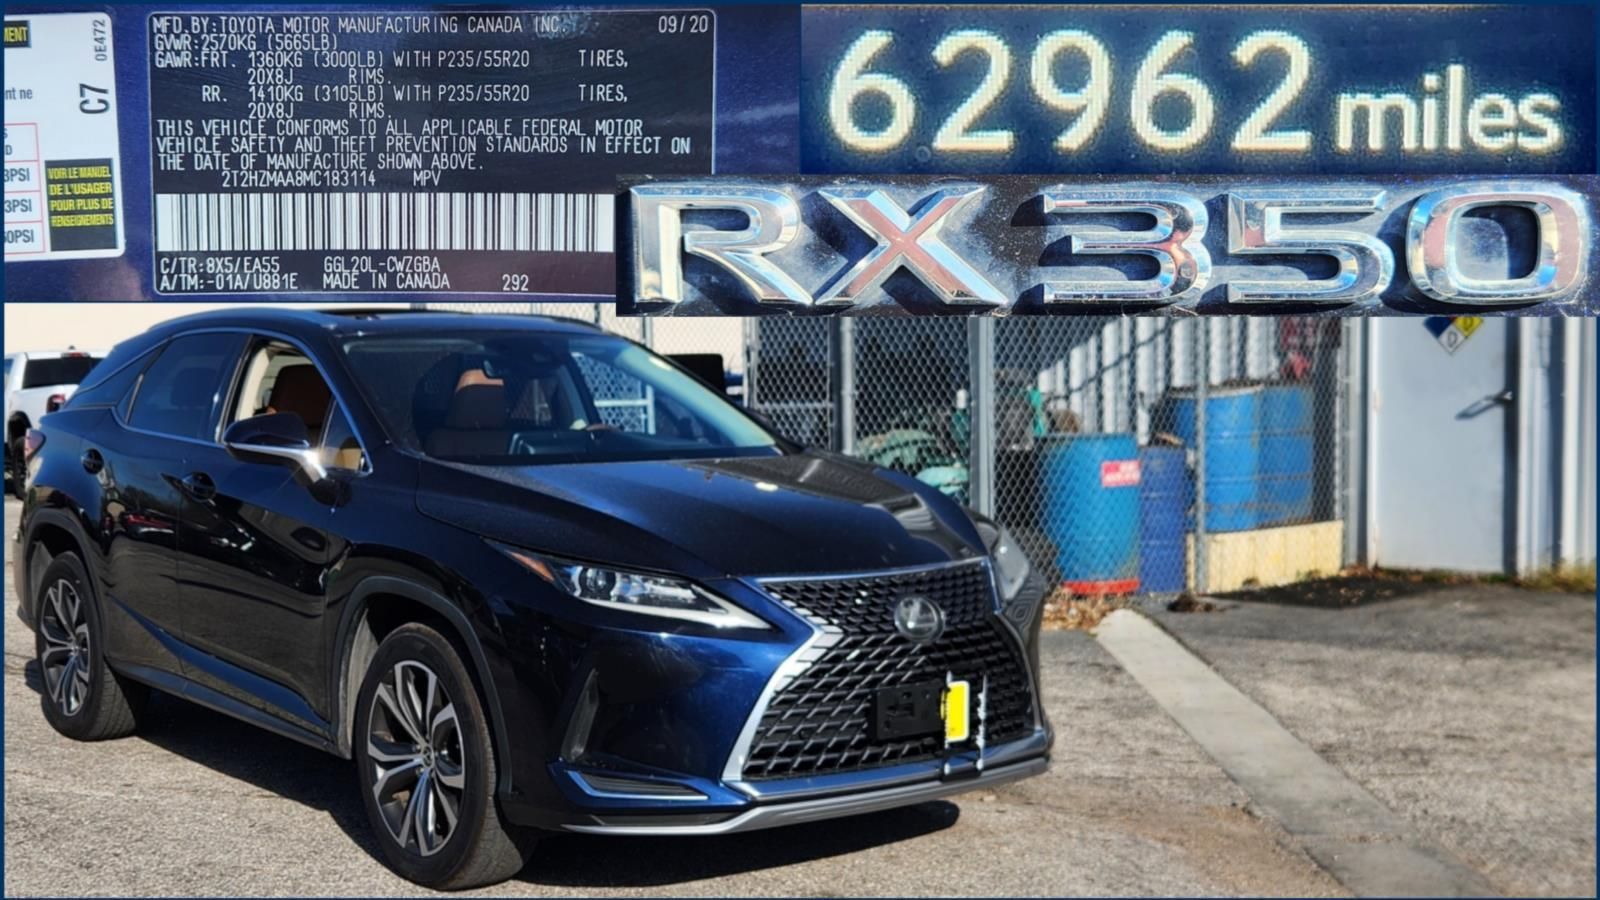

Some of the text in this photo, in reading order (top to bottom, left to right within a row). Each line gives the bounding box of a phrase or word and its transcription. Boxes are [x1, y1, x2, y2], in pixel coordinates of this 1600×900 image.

[282, 16, 330, 33] MOTOR
[338, 16, 458, 33] MANUFACTURING
[467, 16, 523, 33] CANADA
[534, 16, 567, 33] INC.
[657, 15, 709, 33] 09/20
[154, 33, 338, 51] GVWR:2570KG (5665LB)
[154, 49, 629, 69] GAWR:FRT. 1360KG (3000LB) WITH P235/55R20 TIRES,
[247, 68, 392, 86] 20X8J RIMS.
[19, 88, 33, 100] ne
[79, 83, 110, 115] C7
[201, 84, 628, 103] RR. 1410KG (3105LB) WITH P235/55R20 TIRES,
[829, 29, 1564, 153] 62962 miles
[247, 102, 294, 119] 20X8J
[157, 119, 643, 137] THIS VEHICLE CONFORMS TO ALL APPLICABLE FEDERAL MOTOR
[156, 136, 692, 154] VEHICLE SAFETY AND THEFT PREVENTION STANDARDS IN EFFECT ON
[158, 153, 484, 171] THE DATE OF MANUFACTURE SHOWN ABOVE.
[68, 167, 79, 179] LE
[413, 170, 441, 187] MPV
[48, 182, 113, 196] DE L'USAGER
[51, 197, 115, 211] POUR PLUS DE
[630, 182, 1587, 306] RX 350
[159, 256, 281, 275] C/TR:8X5/EA55
[323, 273, 365, 290] MADE
[372, 273, 387, 290] IN
[396, 273, 451, 290] CANADA
[502, 274, 530, 292] 292
